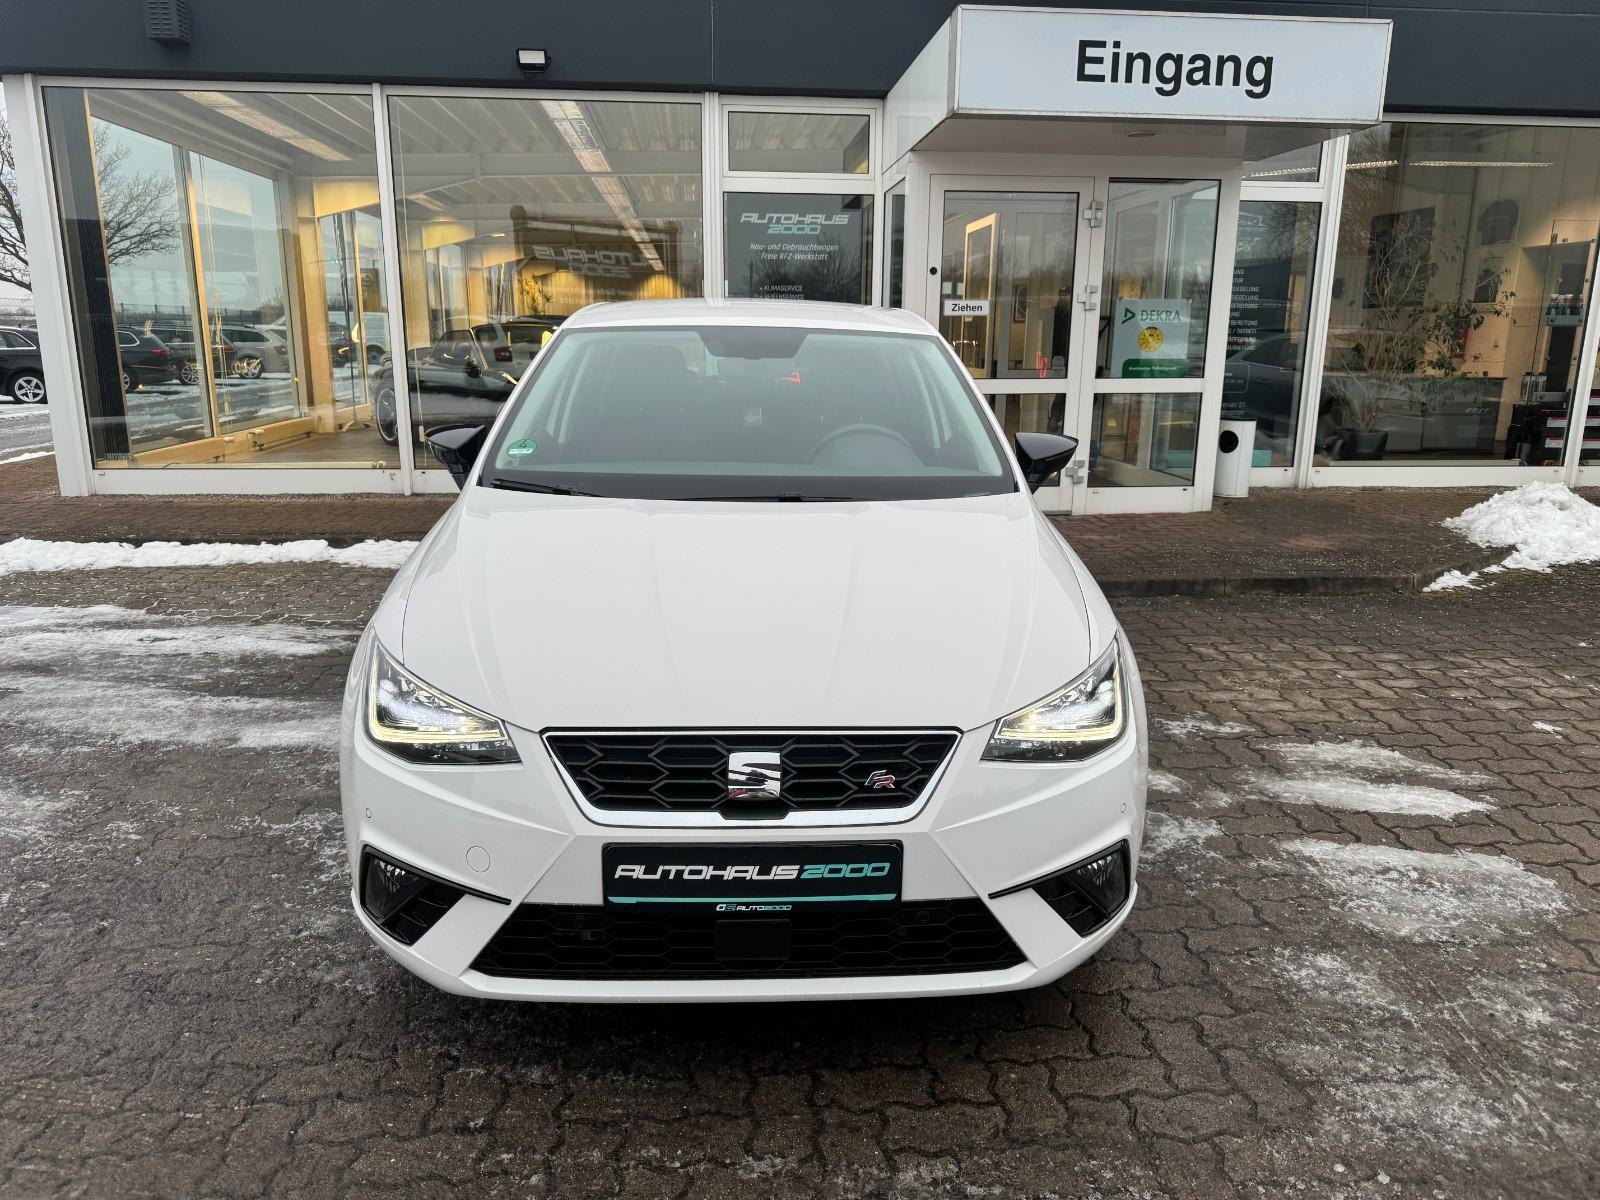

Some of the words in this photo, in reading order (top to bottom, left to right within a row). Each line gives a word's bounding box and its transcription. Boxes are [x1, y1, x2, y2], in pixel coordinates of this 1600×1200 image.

[1076, 39, 1274, 99] Eingang
[740, 213, 851, 225] AUTOHAUS
[767, 224, 821, 235] 2000
[767, 242, 781, 250] und
[782, 243, 839, 252] Gebrauchtwagen
[760, 252, 778, 260] Freie
[779, 252, 829, 261] KFZ-Werkstatt
[951, 303, 983, 312] Ziehen
[1140, 310, 1181, 322] DEKRA
[864, 770, 896, 789] FR
